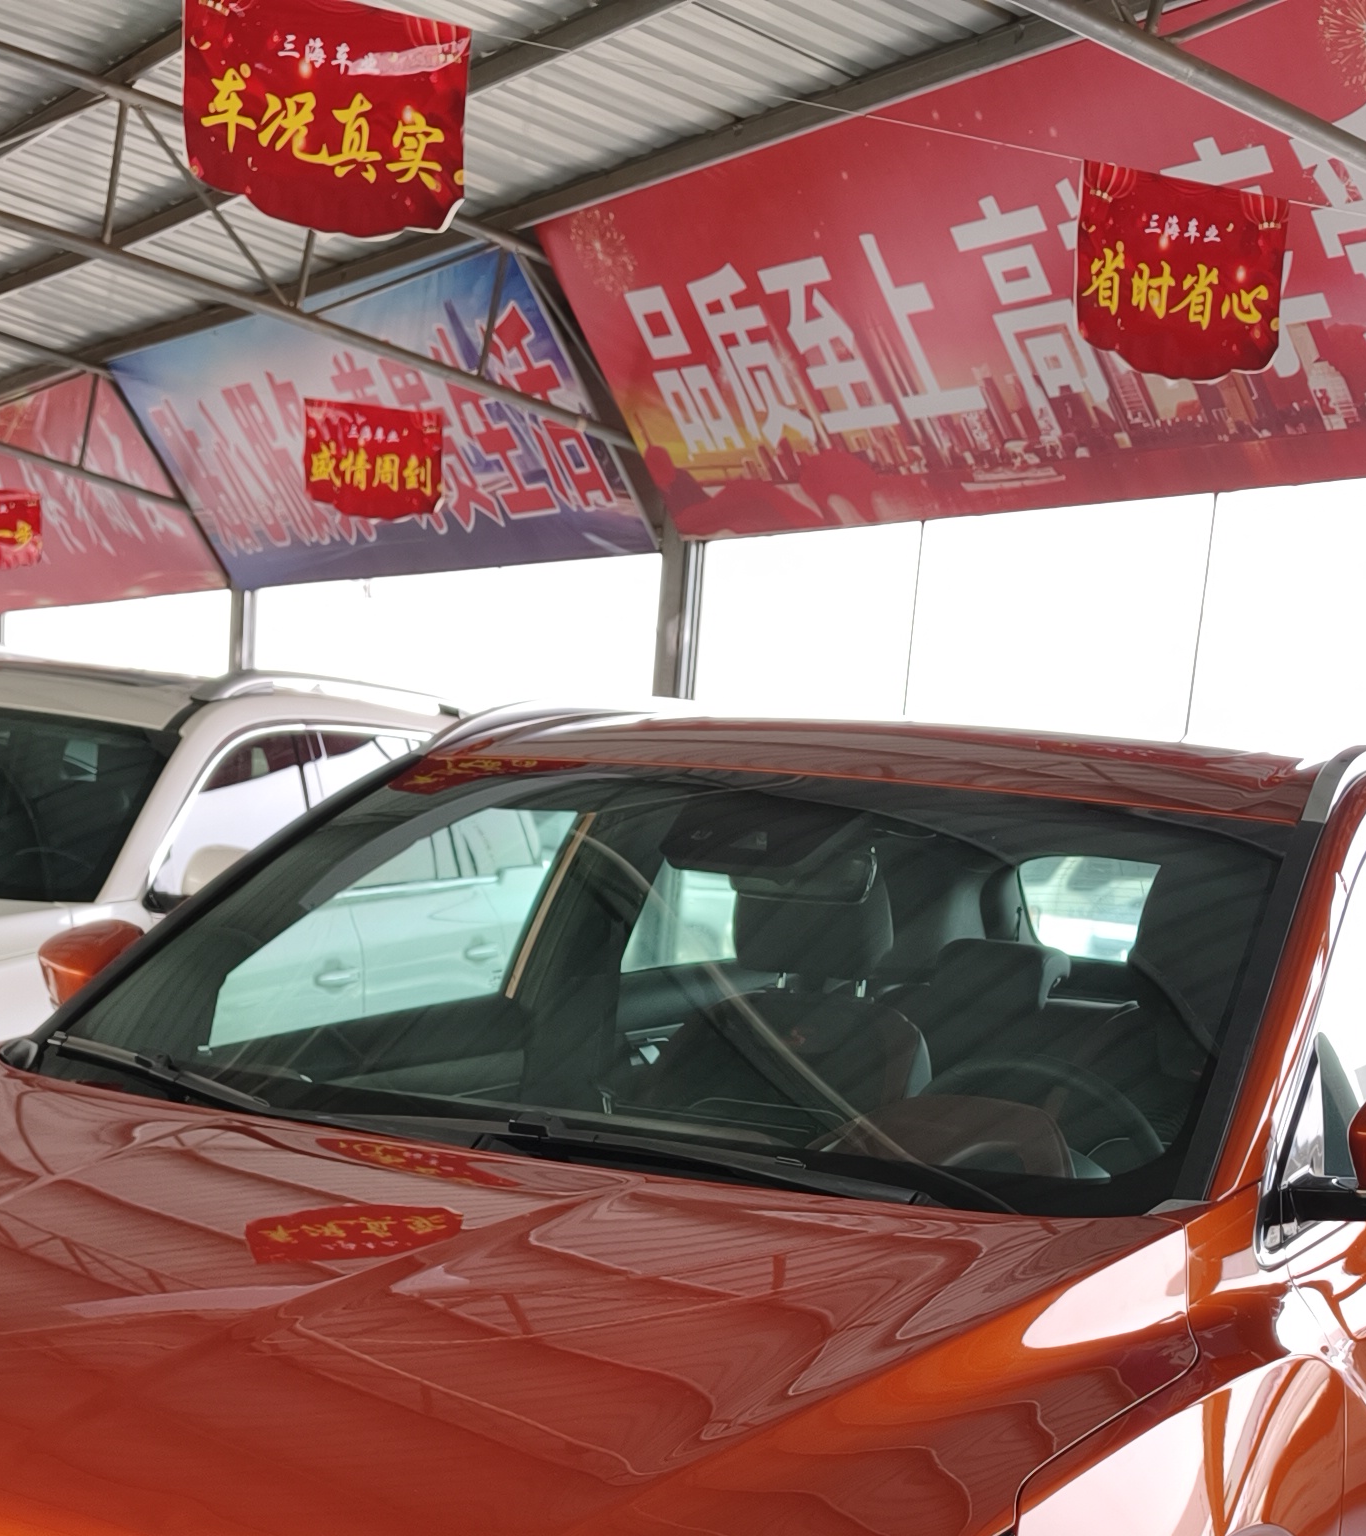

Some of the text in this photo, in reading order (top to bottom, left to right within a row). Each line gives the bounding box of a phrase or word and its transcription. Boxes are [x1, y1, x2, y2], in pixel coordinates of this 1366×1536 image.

[201, 68, 445, 191] 车况真实
[1144, 213, 1221, 244] 三海车业
[1081, 247, 1269, 331] 省时省心
